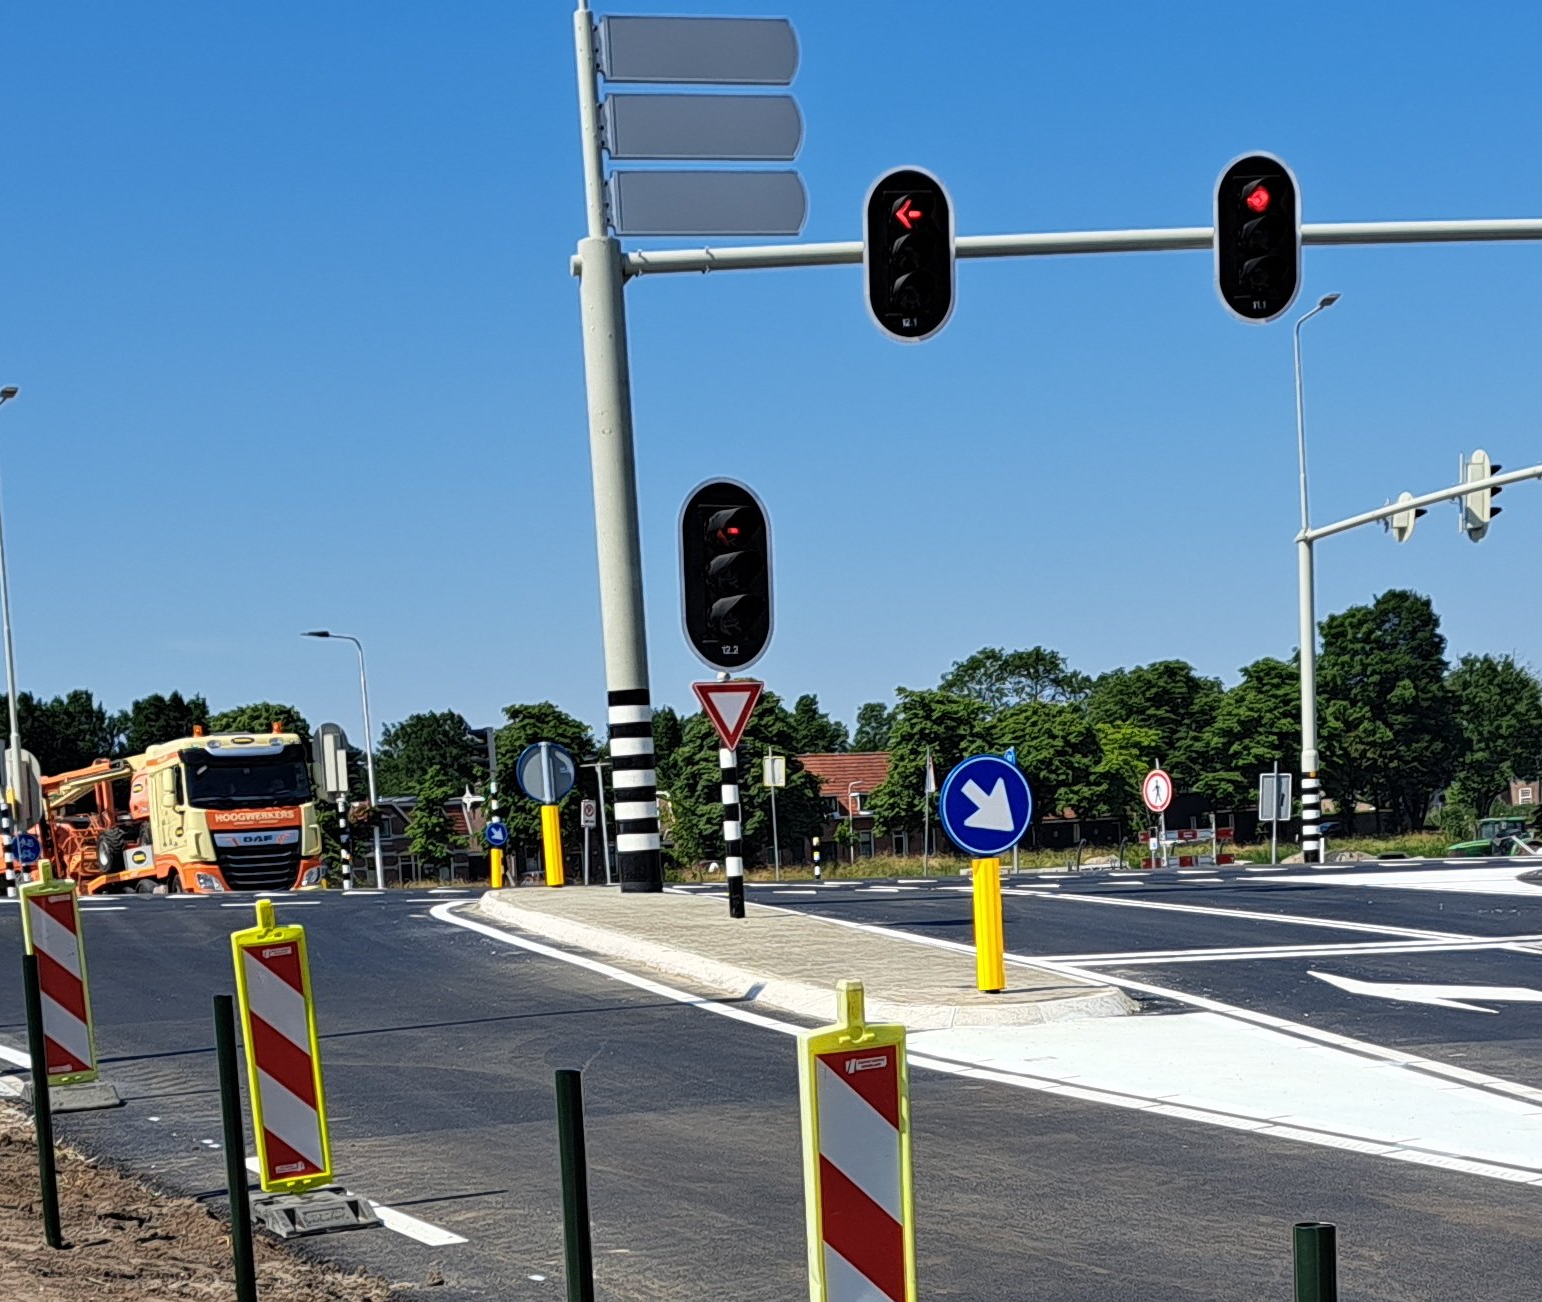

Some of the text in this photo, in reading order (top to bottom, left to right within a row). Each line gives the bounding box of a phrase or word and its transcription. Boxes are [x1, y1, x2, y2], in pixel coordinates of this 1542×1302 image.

[721, 645, 739, 655] 12.2
[214, 810, 295, 823] HOOGWERKERS
[243, 835, 273, 844] DAF
